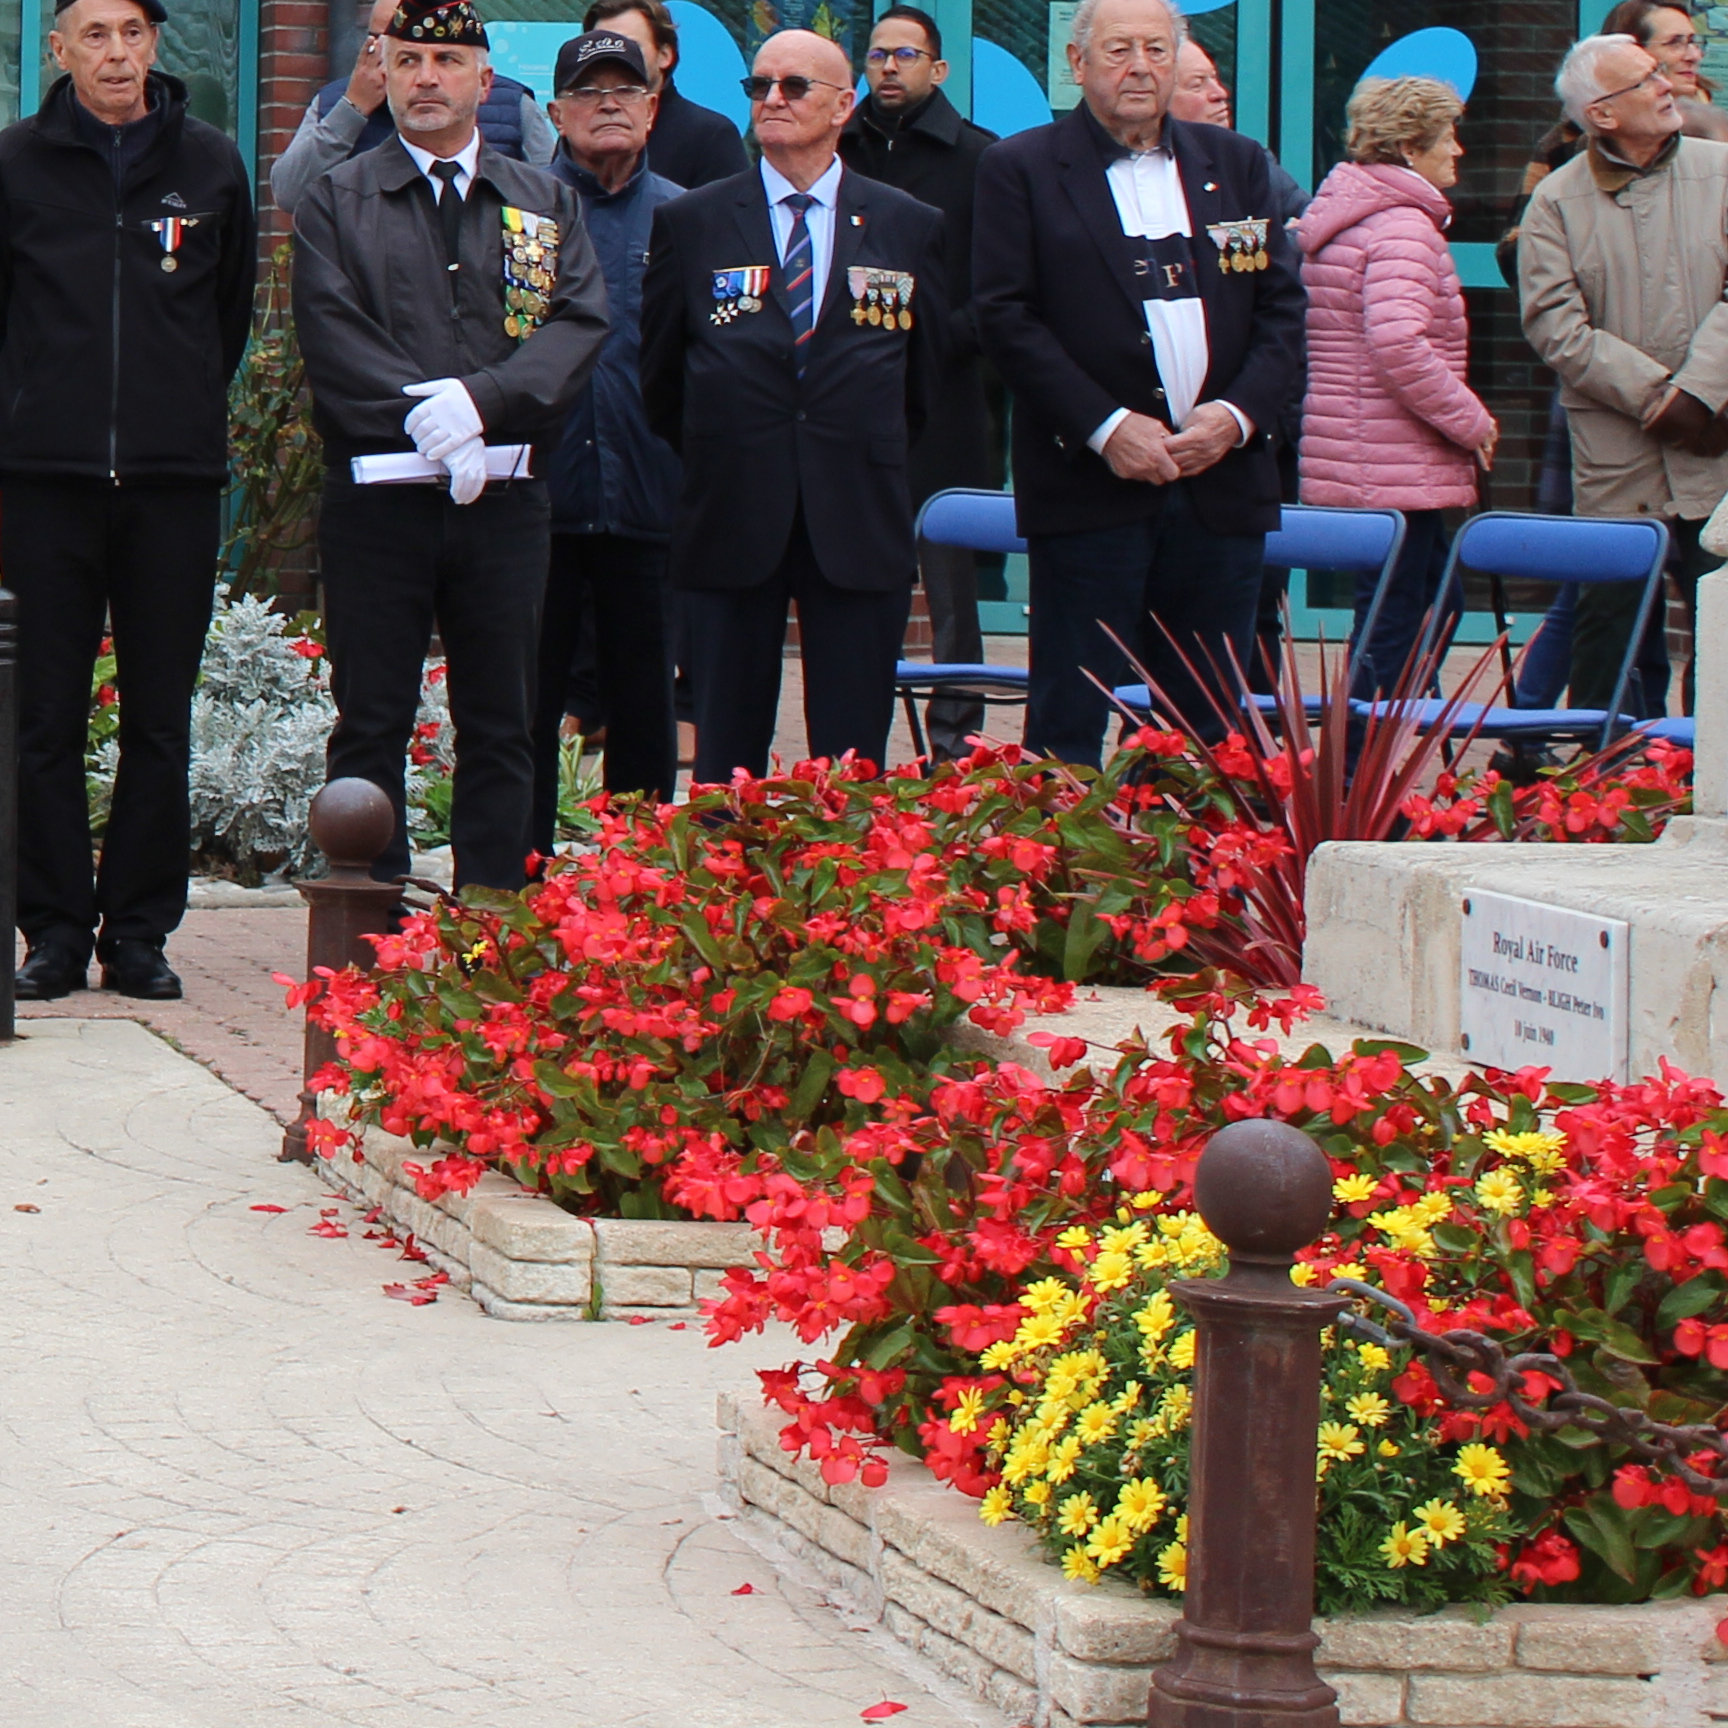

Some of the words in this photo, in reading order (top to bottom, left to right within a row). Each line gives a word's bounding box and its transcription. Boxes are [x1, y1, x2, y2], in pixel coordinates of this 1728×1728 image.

[1493, 931, 1523, 964] Royal
[1526, 939, 1545, 965] Air
[1547, 944, 1578, 973] Force
[1468, 968, 1499, 992] THOMAS
[1522, 1020, 1537, 1044] juin
